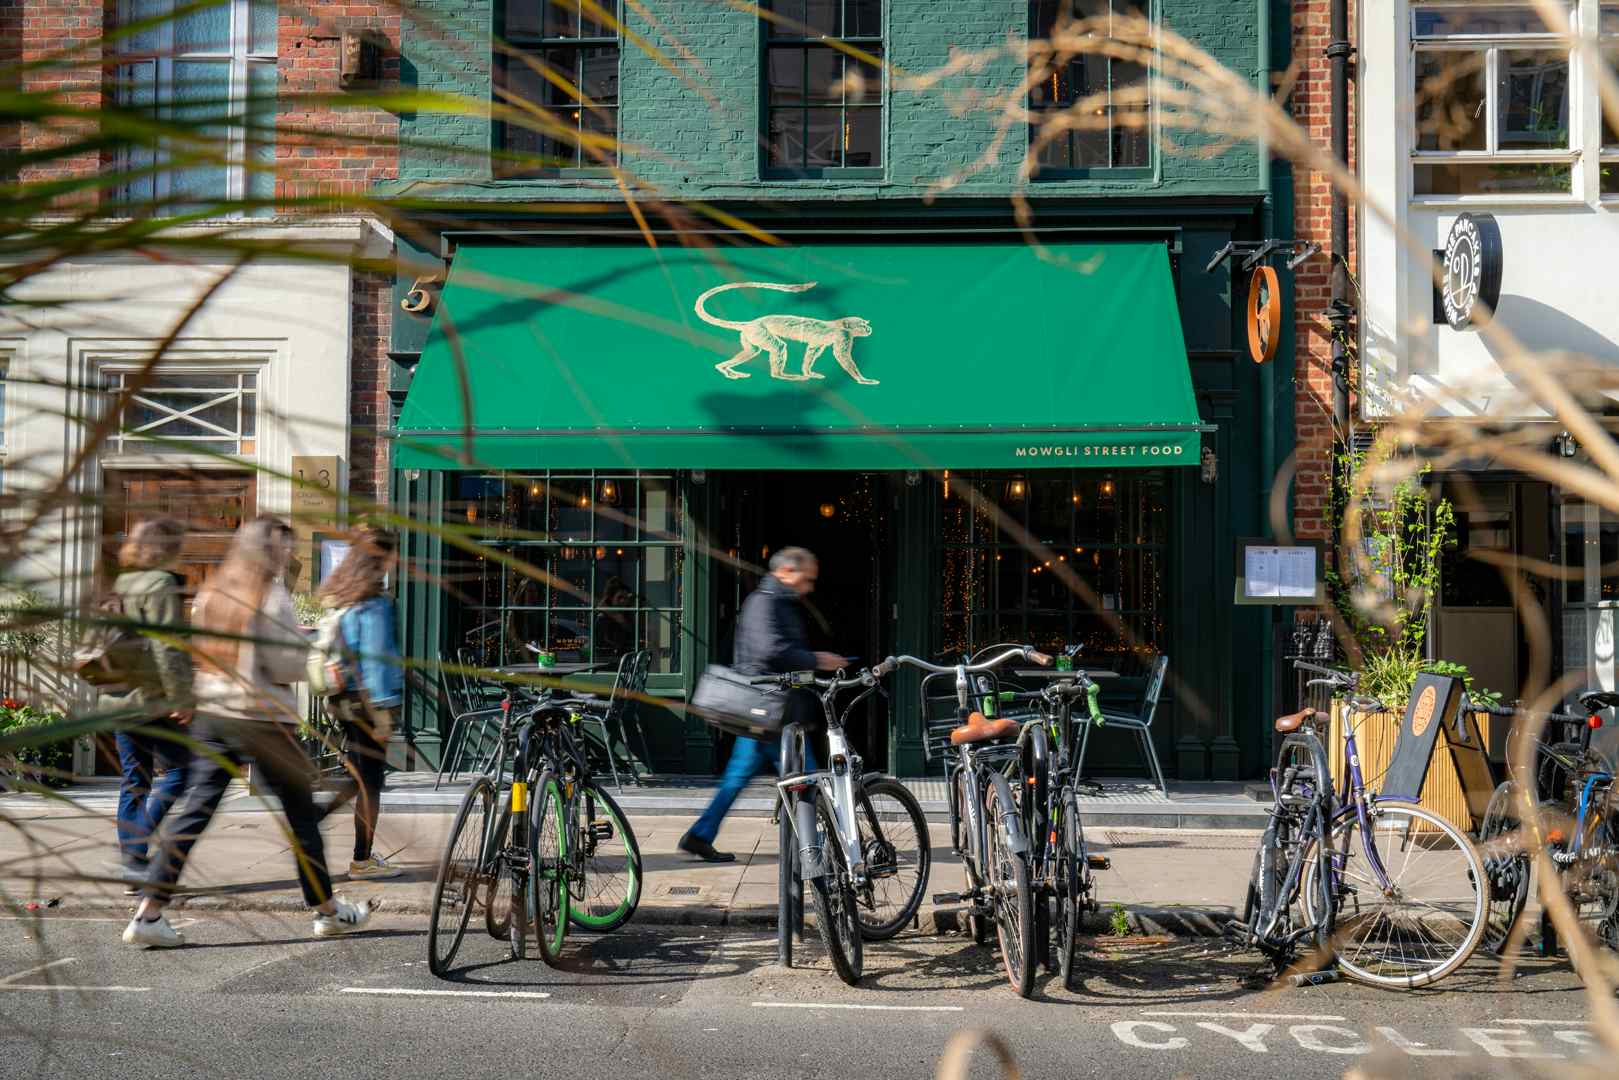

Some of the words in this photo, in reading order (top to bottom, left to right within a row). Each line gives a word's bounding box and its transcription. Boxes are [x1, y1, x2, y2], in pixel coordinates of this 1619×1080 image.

[1015, 447, 1078, 457] MOWGLI
[1083, 446, 1136, 456] STREET
[1142, 446, 1183, 456] FOOD
